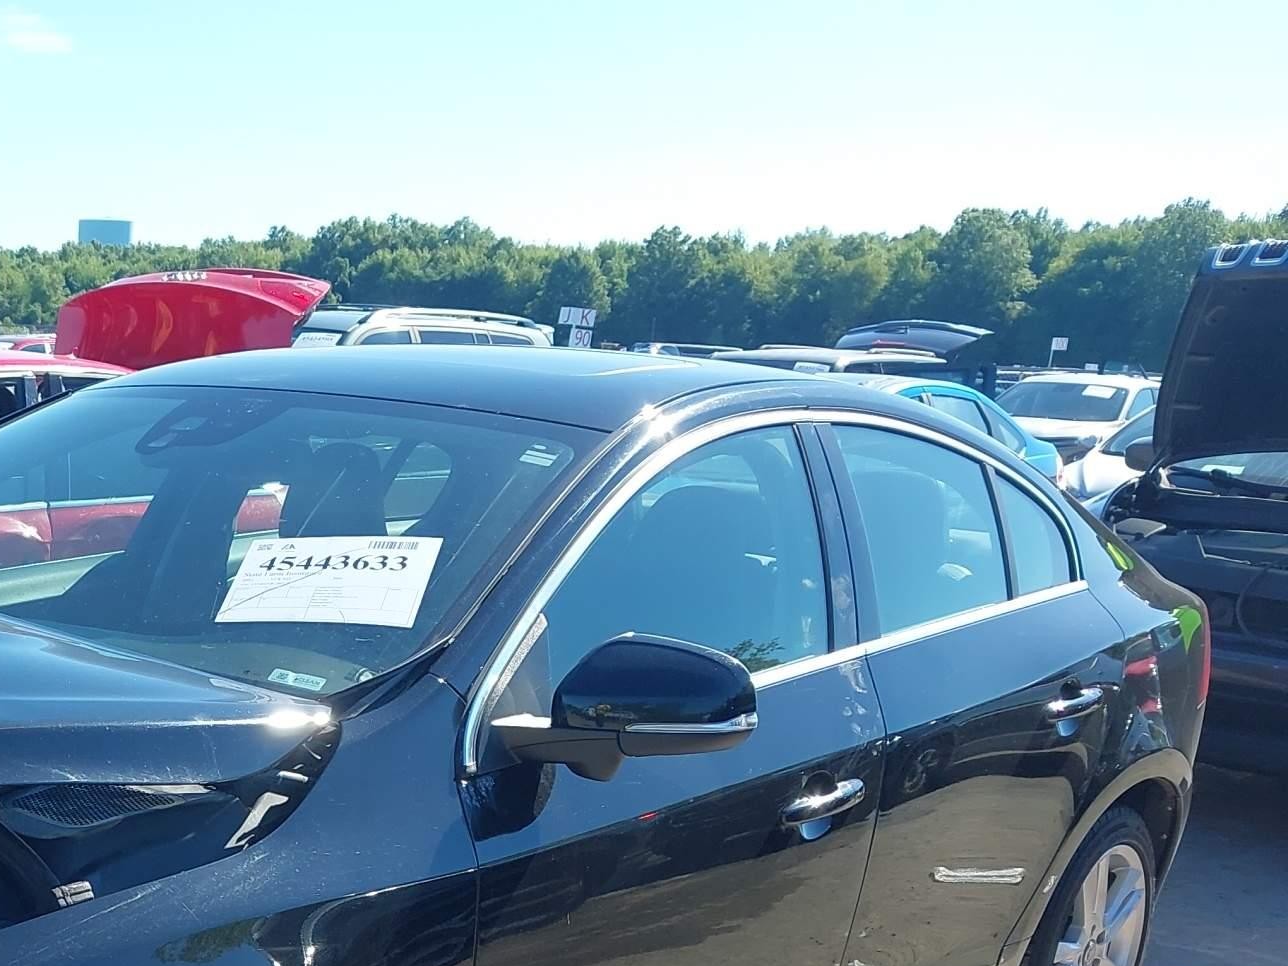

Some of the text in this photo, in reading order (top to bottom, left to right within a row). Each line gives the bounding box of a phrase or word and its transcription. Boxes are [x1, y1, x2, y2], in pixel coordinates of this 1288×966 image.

[562, 307, 592, 325] J K
[575, 330, 591, 347] 90
[259, 554, 409, 571] 45443633
